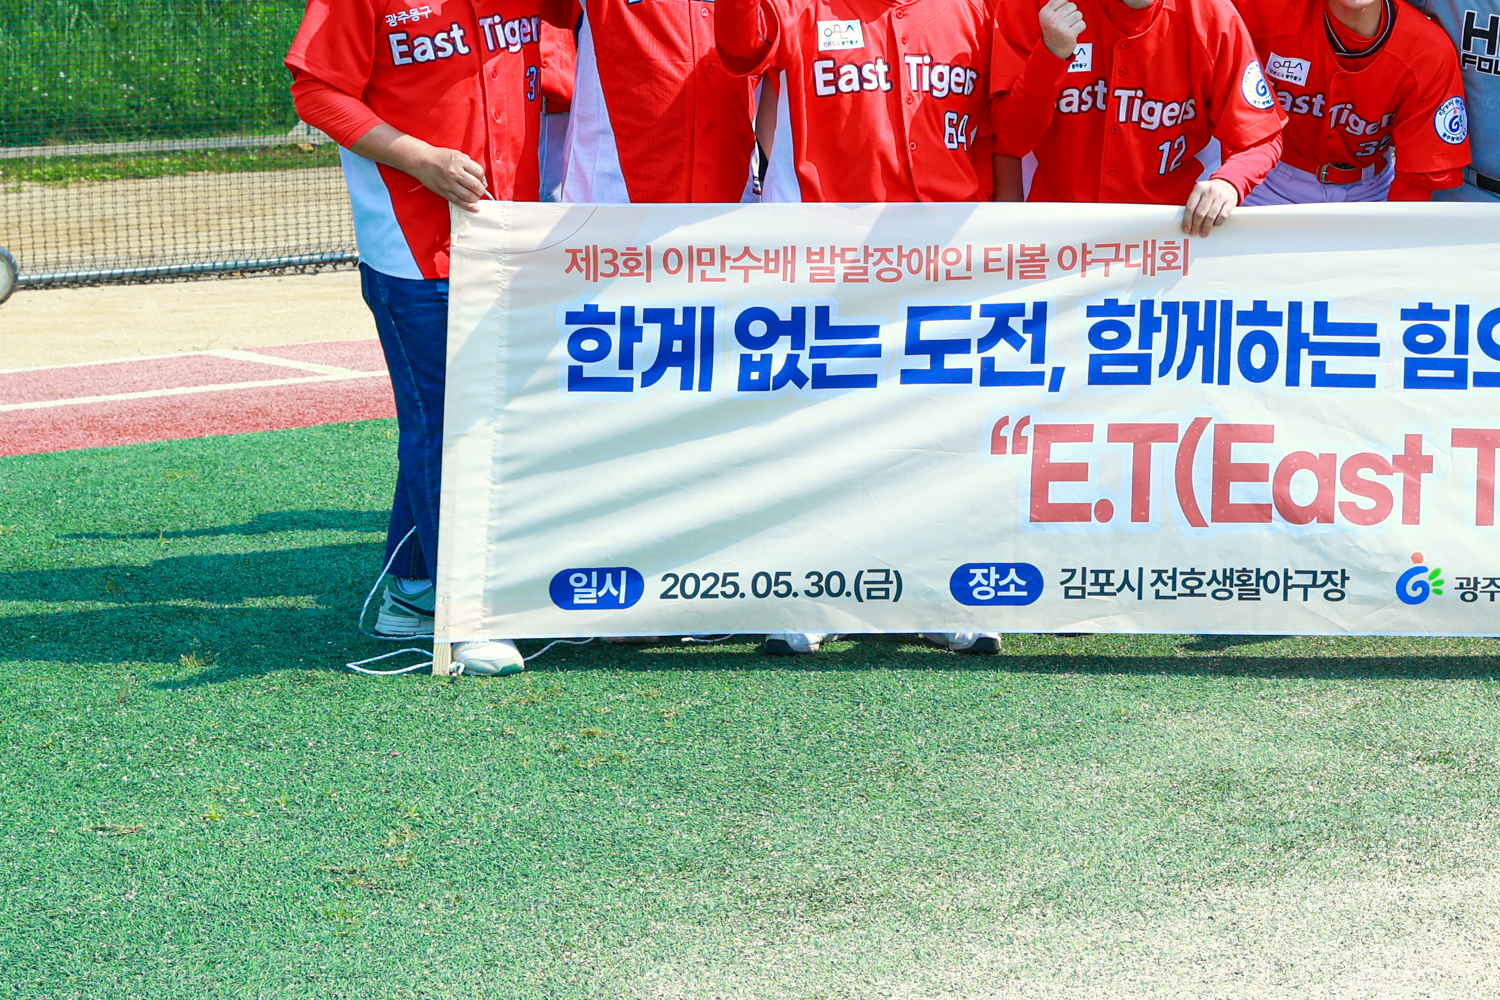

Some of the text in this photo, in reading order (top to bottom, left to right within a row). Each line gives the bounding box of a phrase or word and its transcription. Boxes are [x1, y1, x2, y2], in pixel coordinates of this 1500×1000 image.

[385, 5, 433, 27] 광주동구
[387, 14, 540, 67] East Tiger
[813, 55, 893, 97] East
[1055, 77, 1108, 114] ast
[1275, 88, 1326, 119] ast
[943, 110, 970, 152] 64
[1158, 135, 1187, 175] 12
[564, 238, 1191, 284] 제3회 이만수배 발달장애인 티볼 야구대회
[564, 303, 716, 393] 한계
[734, 304, 883, 392] 없는
[899, 300, 1066, 394] 도전,
[1086, 298, 1381, 390] 함께하는
[990, 415, 1434, 529] “E.T(East
[568, 570, 627, 605] 일시
[968, 566, 1029, 600] 장소
[1058, 566, 1350, 602] 김포시 전호생활야구장
